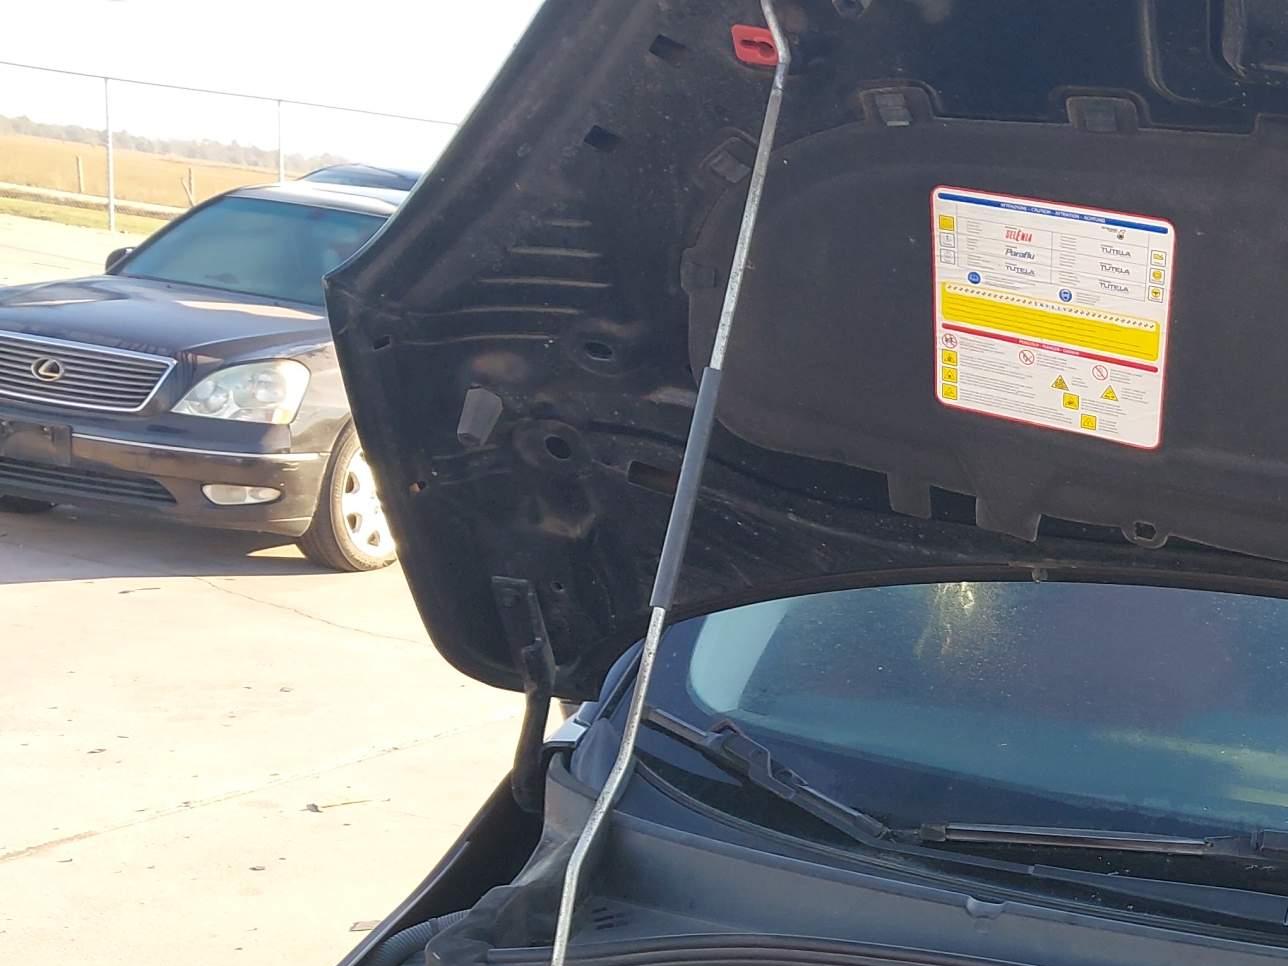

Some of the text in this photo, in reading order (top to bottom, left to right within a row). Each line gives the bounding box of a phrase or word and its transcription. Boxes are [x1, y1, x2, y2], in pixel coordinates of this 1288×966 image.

[1005, 248, 1036, 260] Paraflu
[1101, 247, 1132, 257] TUTELA
[1007, 265, 1036, 276] TUTELA
[1099, 264, 1130, 275] TUTELA
[1099, 282, 1129, 293] TUTELA
